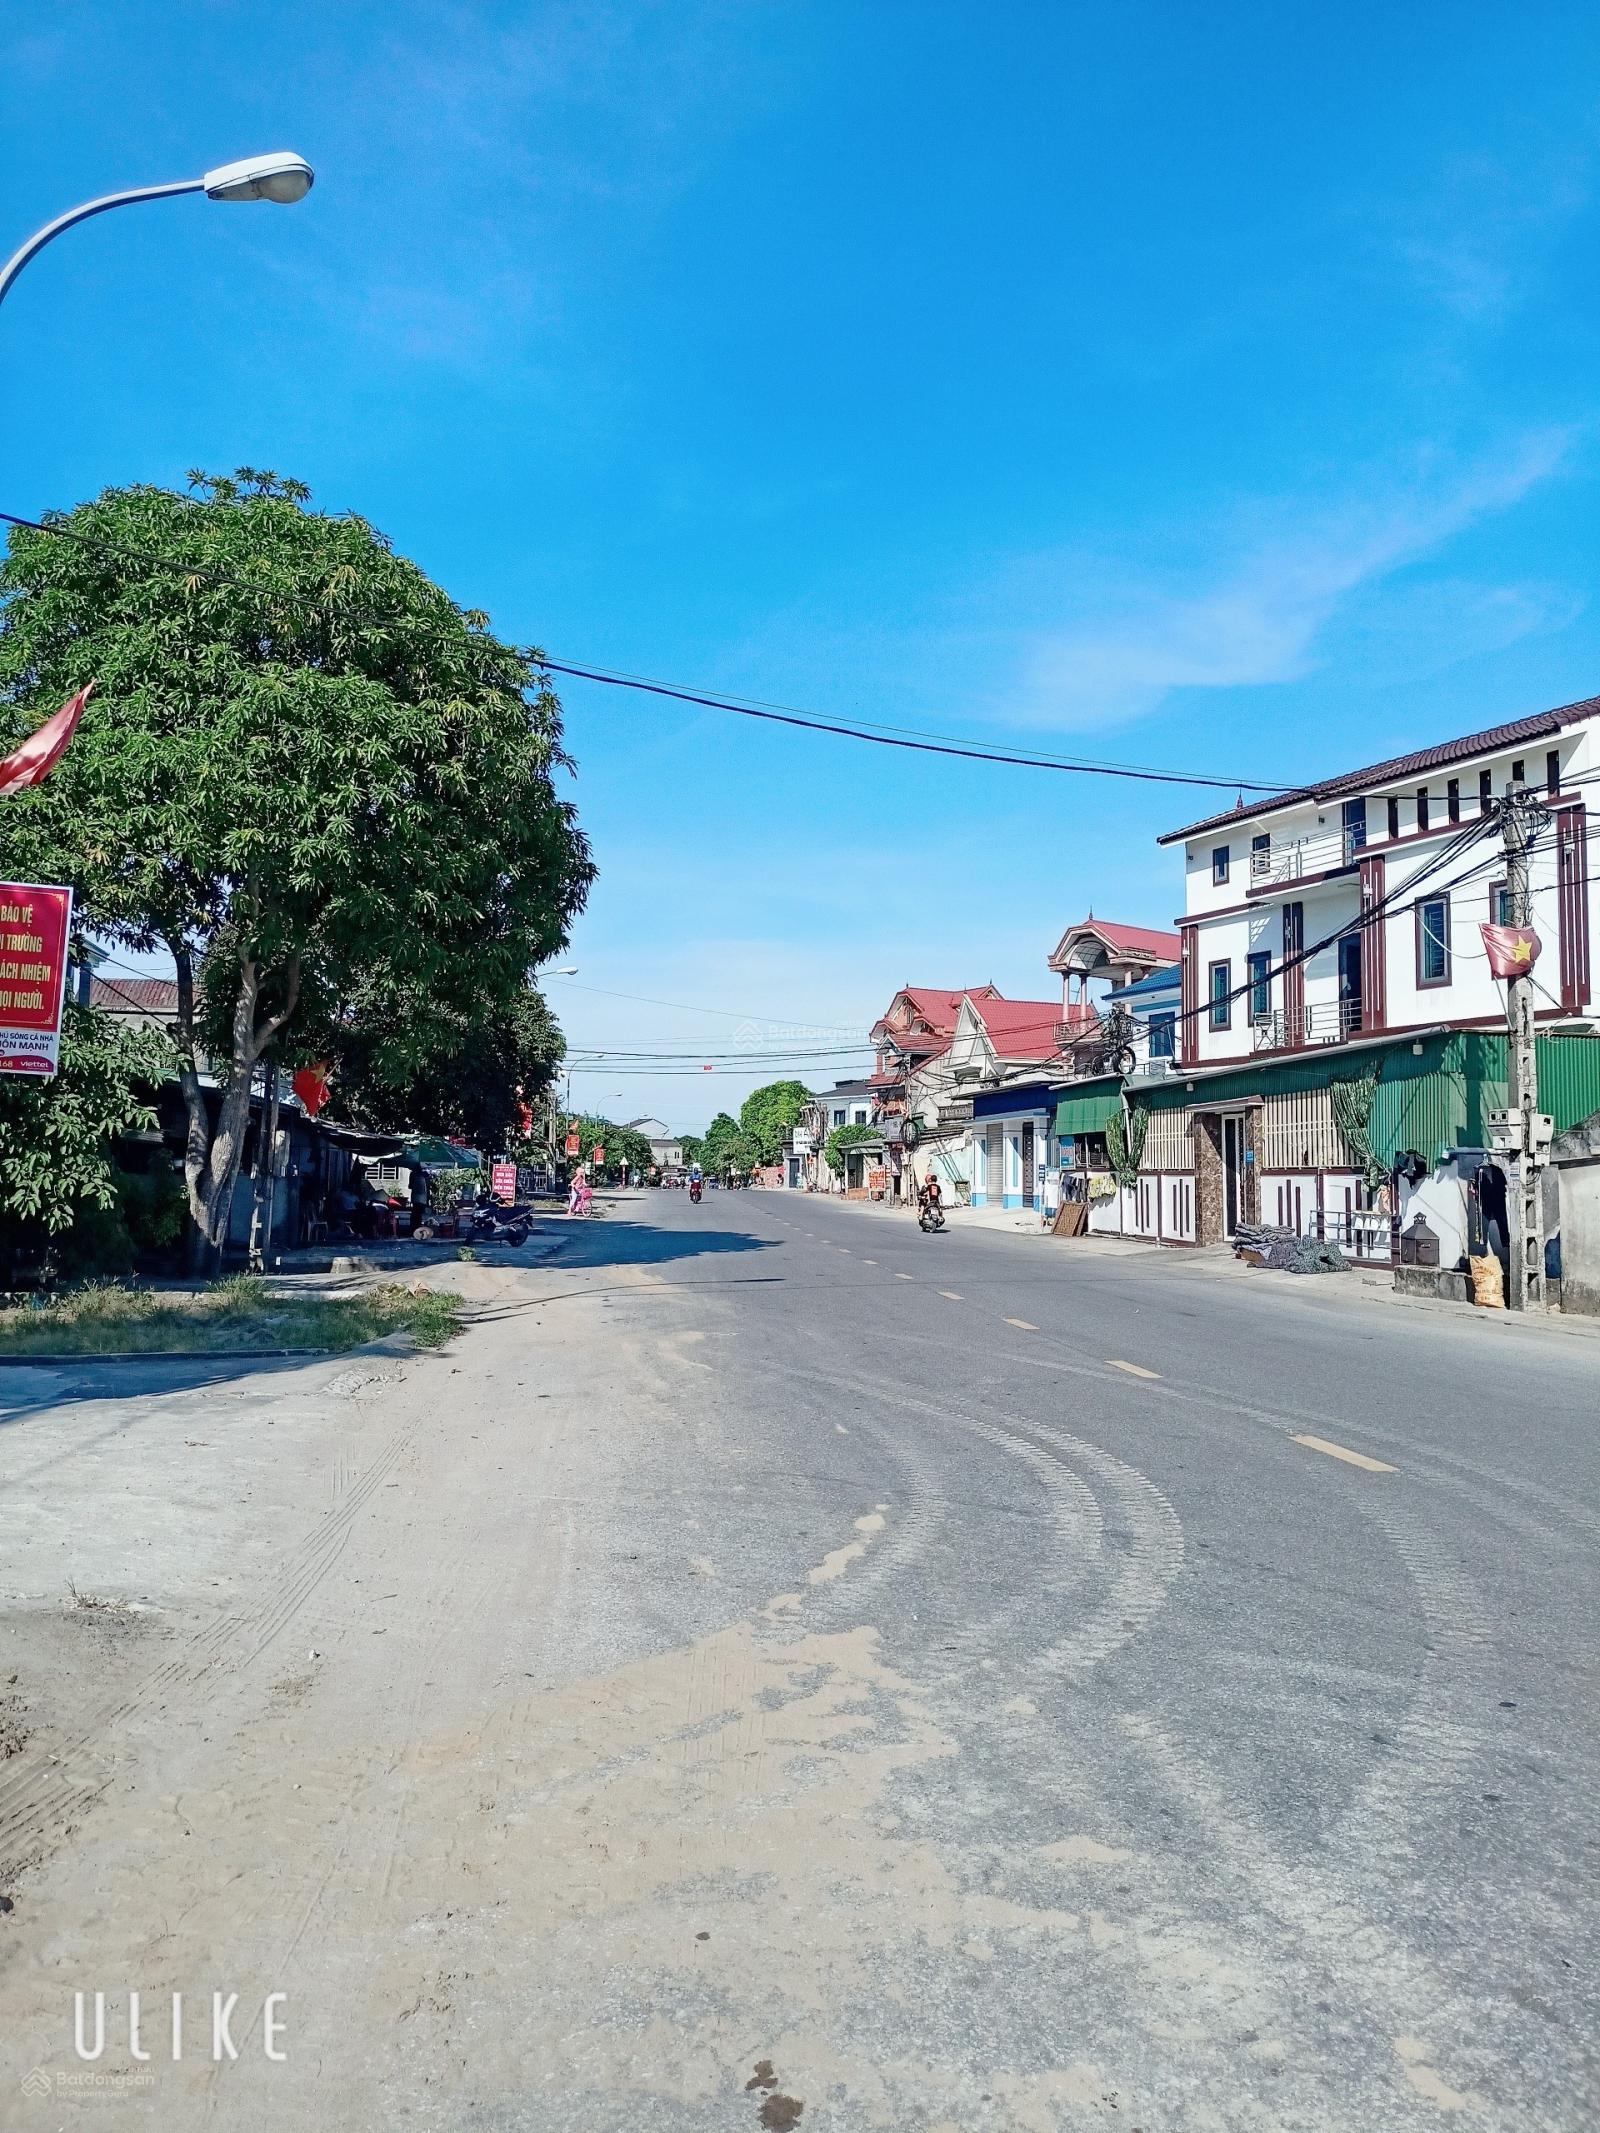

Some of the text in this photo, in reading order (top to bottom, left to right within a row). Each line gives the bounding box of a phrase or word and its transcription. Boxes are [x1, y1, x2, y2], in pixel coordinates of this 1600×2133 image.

[1, 900, 34, 927] BẢO VỆ
[7, 931, 43, 952] TRƯỜNG
[20, 961, 51, 984] NHIỆM
[10, 1032, 29, 1040] SÓNG
[19, 1042, 49, 1052] MẠNH
